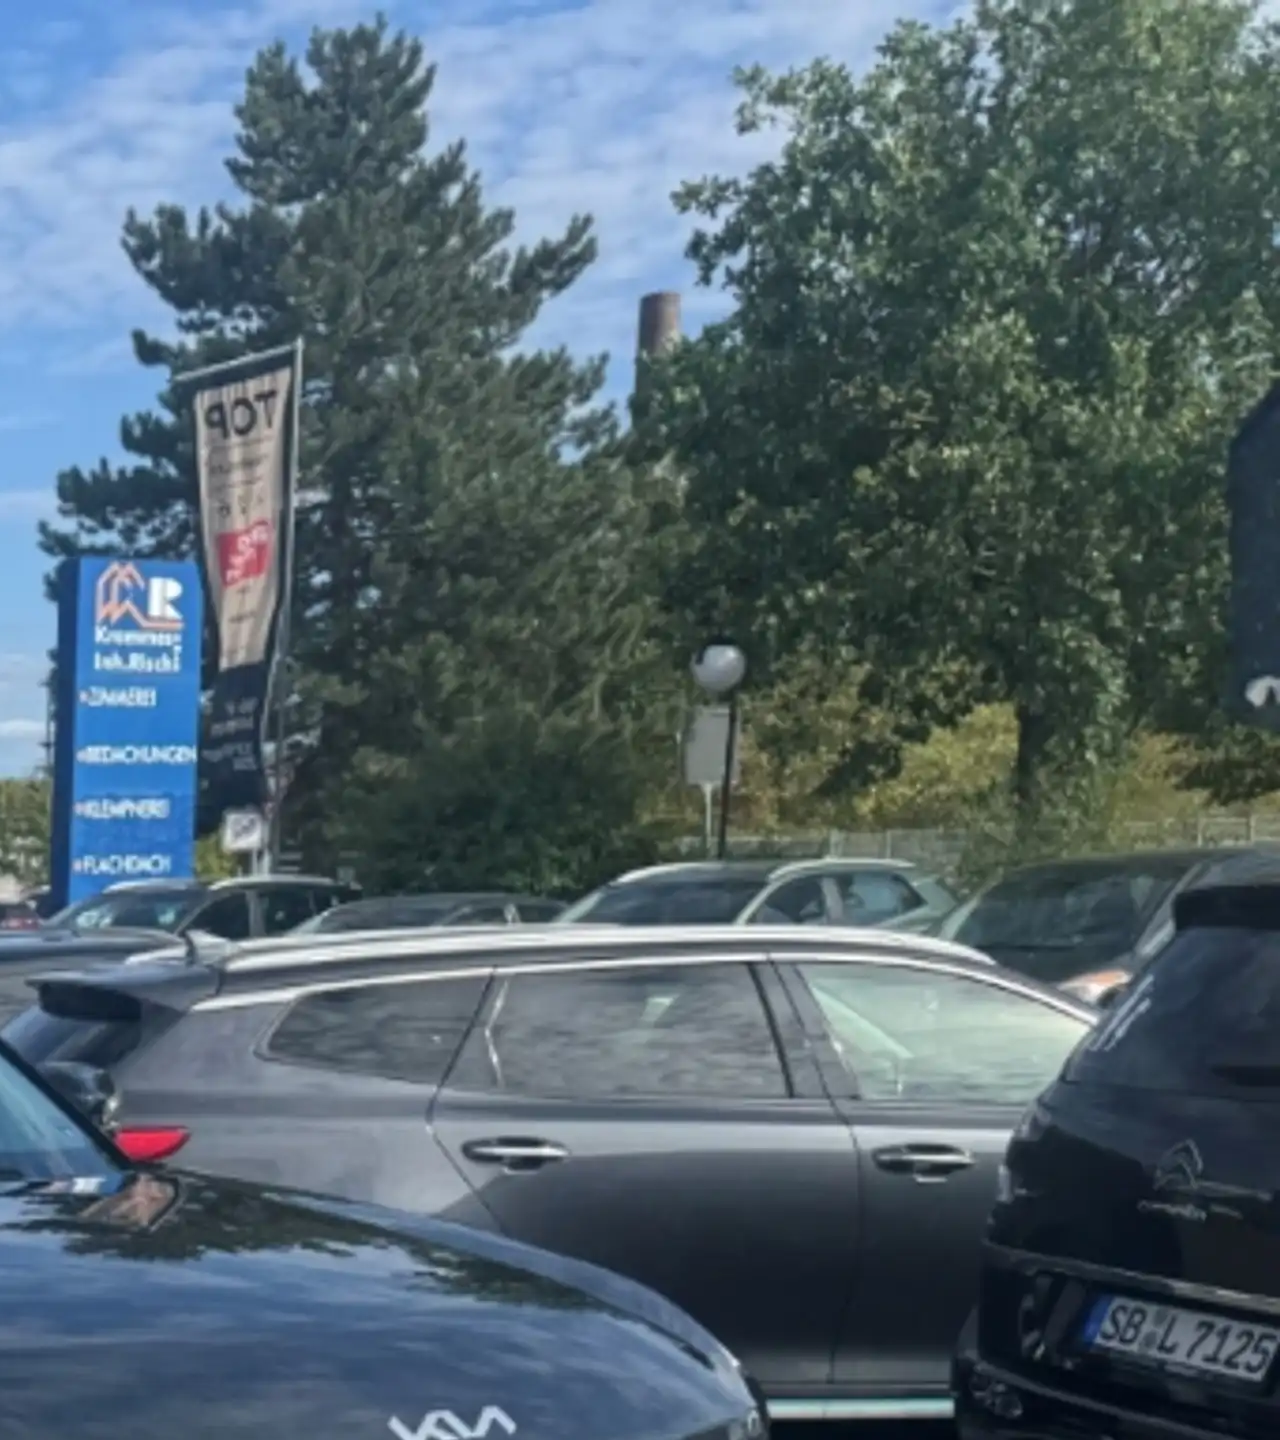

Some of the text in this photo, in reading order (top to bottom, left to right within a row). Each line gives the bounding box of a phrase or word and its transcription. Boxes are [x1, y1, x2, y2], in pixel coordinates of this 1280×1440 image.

[83, 855, 172, 875] FLACHDACH
[1099, 1304, 1278, 1374] SB L 7125
